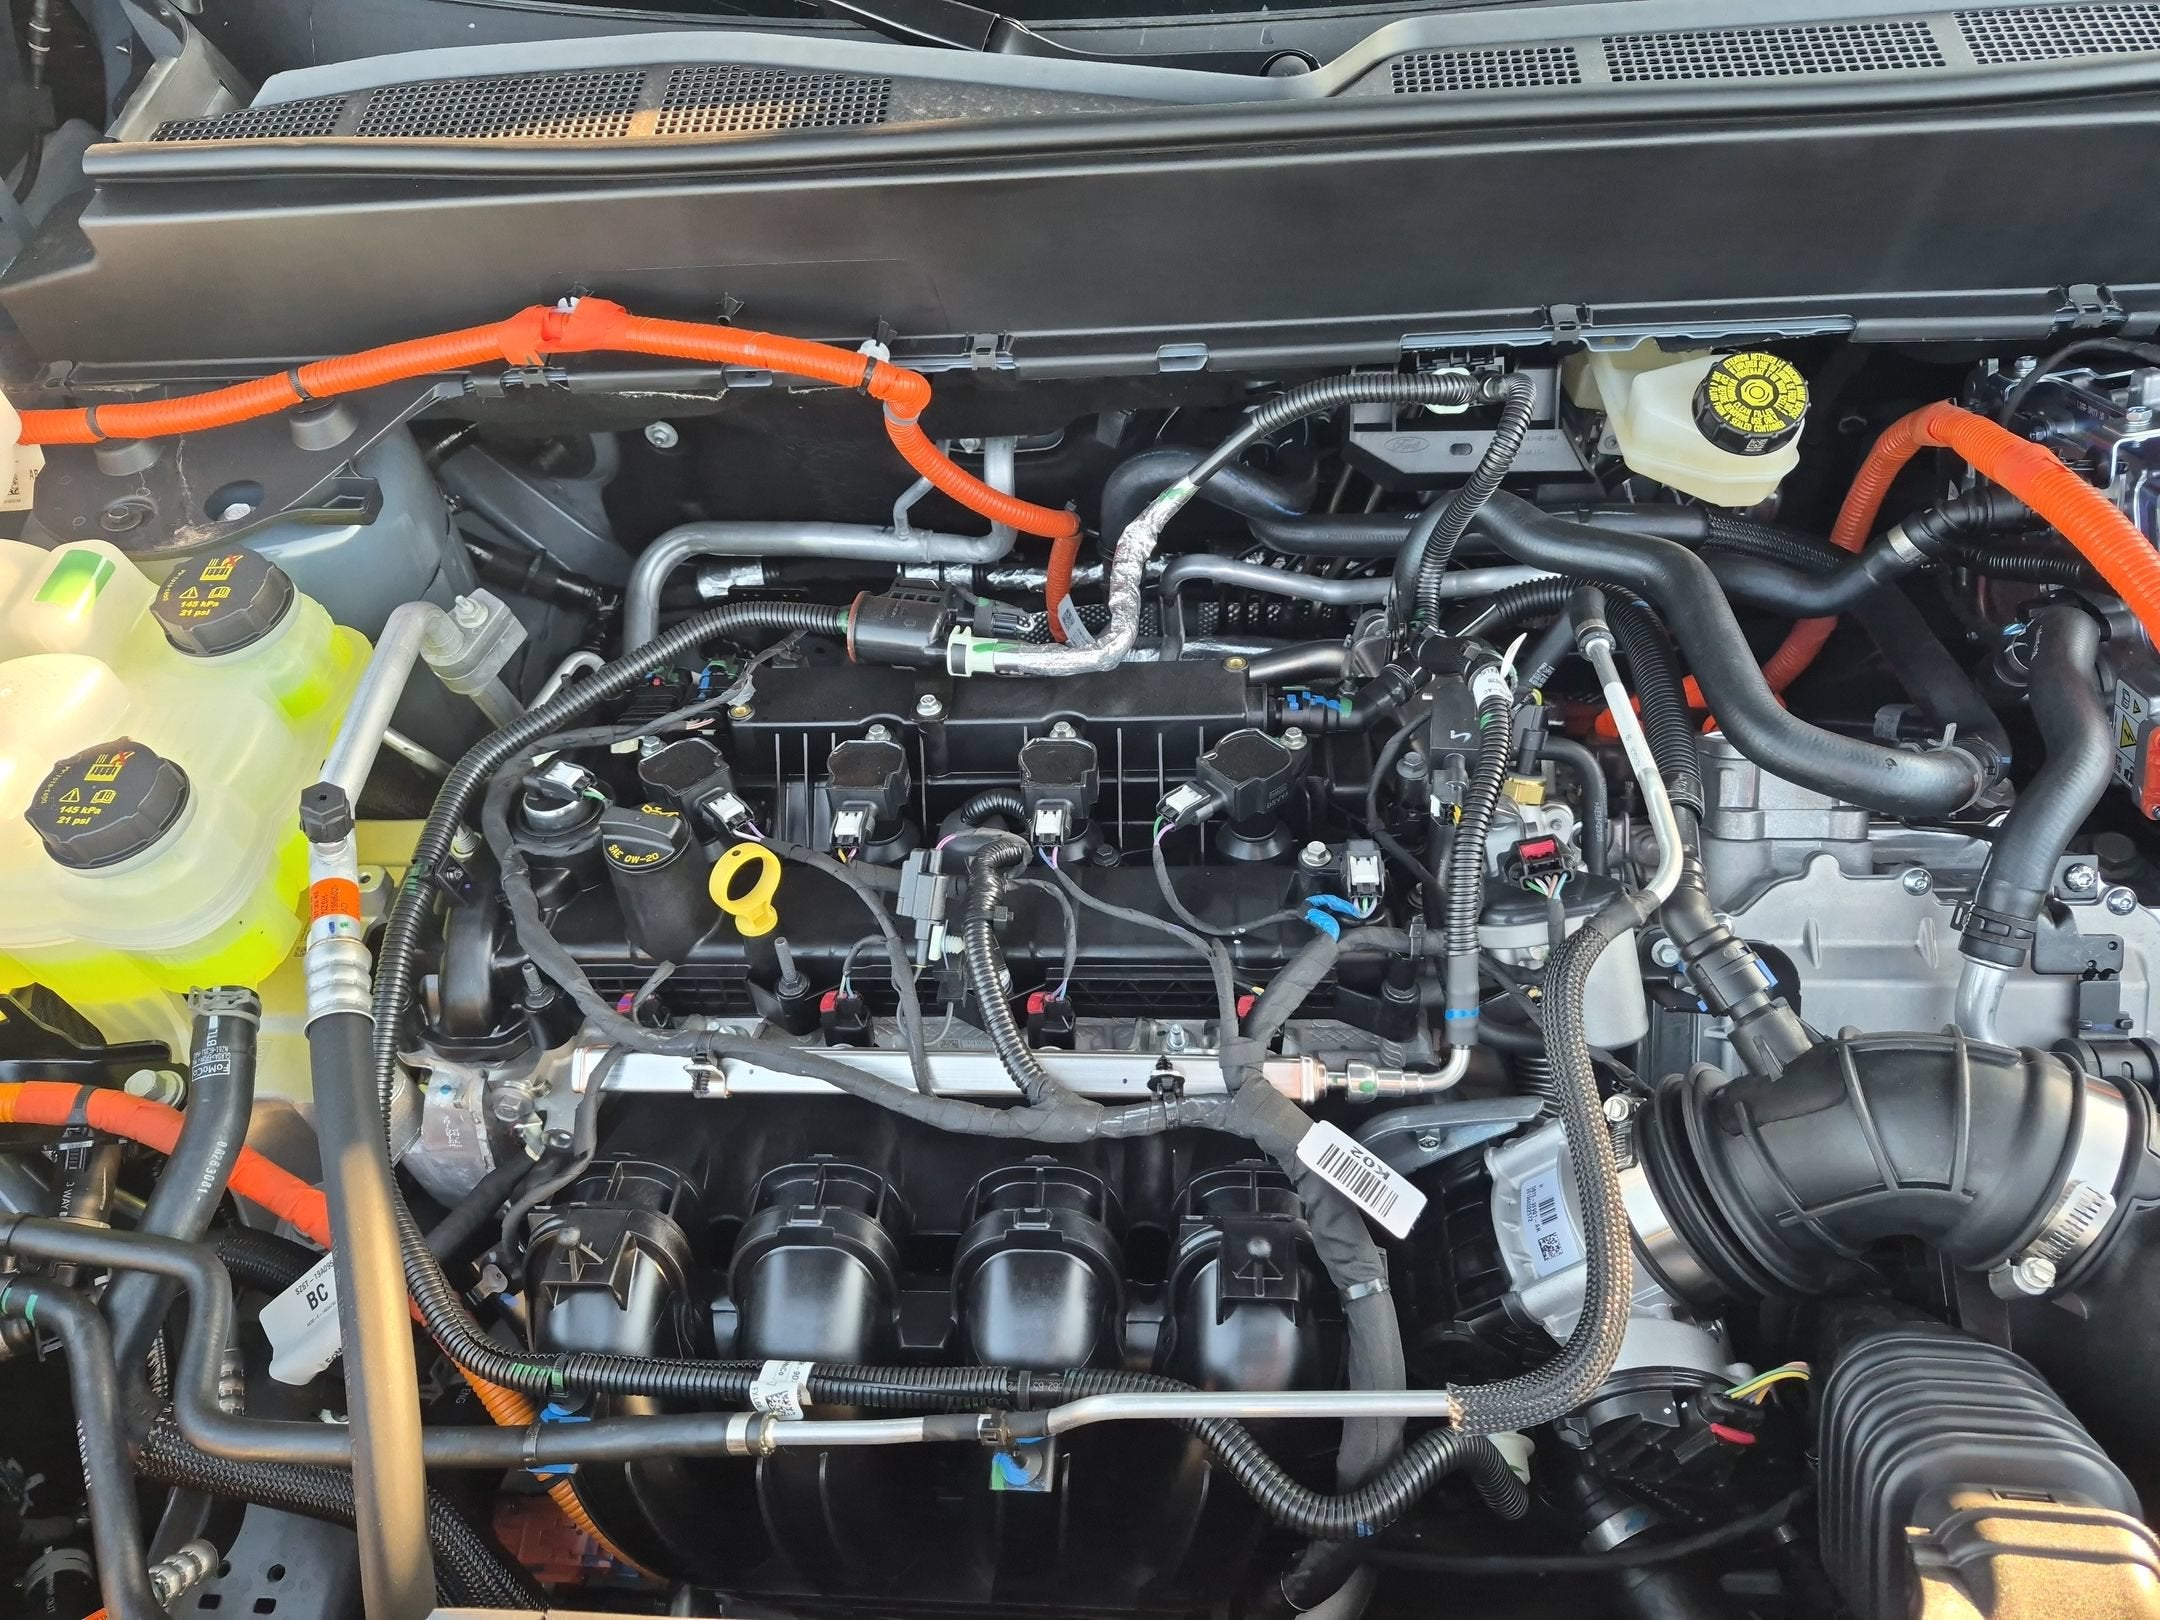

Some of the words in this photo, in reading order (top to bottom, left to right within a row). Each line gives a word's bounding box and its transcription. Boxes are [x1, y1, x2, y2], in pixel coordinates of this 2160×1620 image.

[193, 609, 211, 617] psi
[80, 806, 102, 815] kPa
[72, 817, 92, 826] psi
[608, 844, 624, 859] SAE
[624, 852, 660, 864] 0W-20
[192, 1062, 229, 1077] FoMoCo
[61, 1189, 72, 1210] WAY
[306, 1283, 329, 1311] BC
